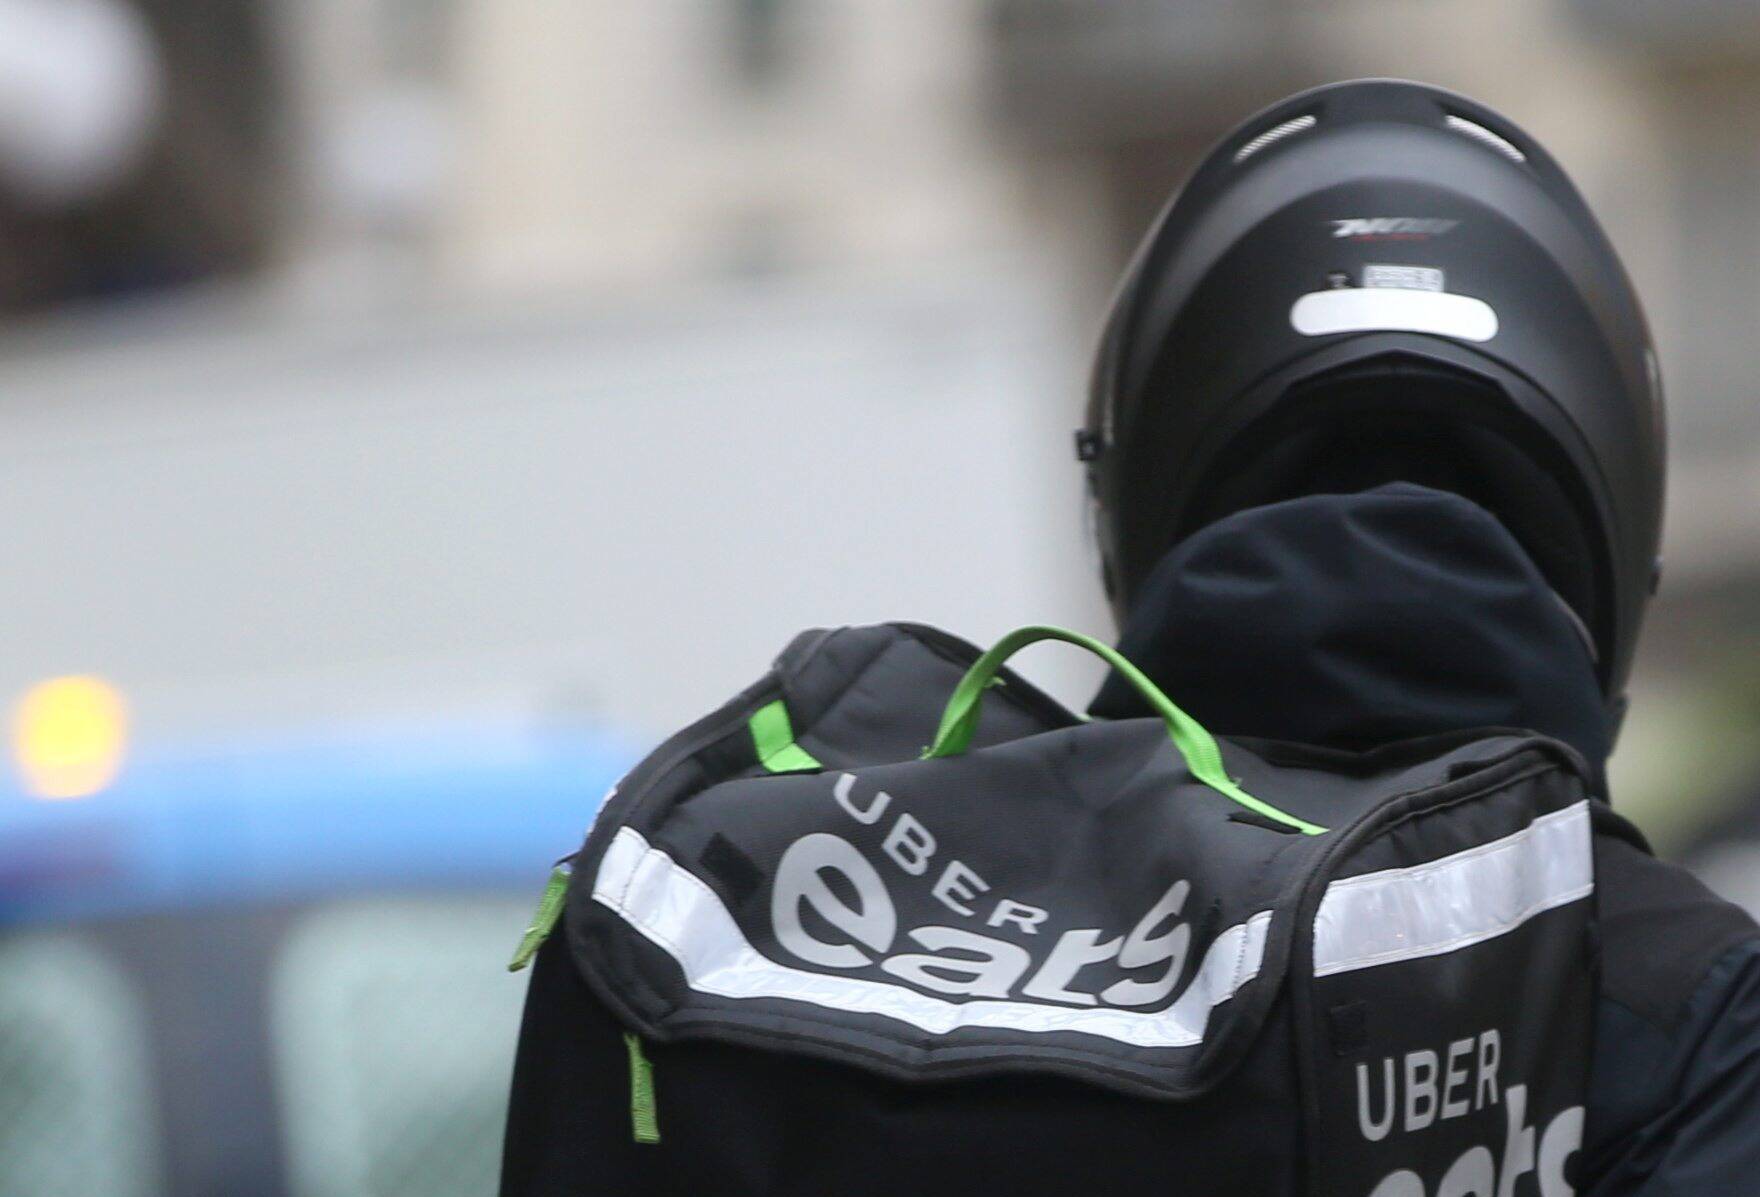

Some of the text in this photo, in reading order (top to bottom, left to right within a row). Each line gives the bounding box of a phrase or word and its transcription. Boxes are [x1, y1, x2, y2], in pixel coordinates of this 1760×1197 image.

[771, 832, 1191, 1006] eats
[832, 772, 1049, 936] UBER
[1356, 1028, 1501, 1142] UBER
